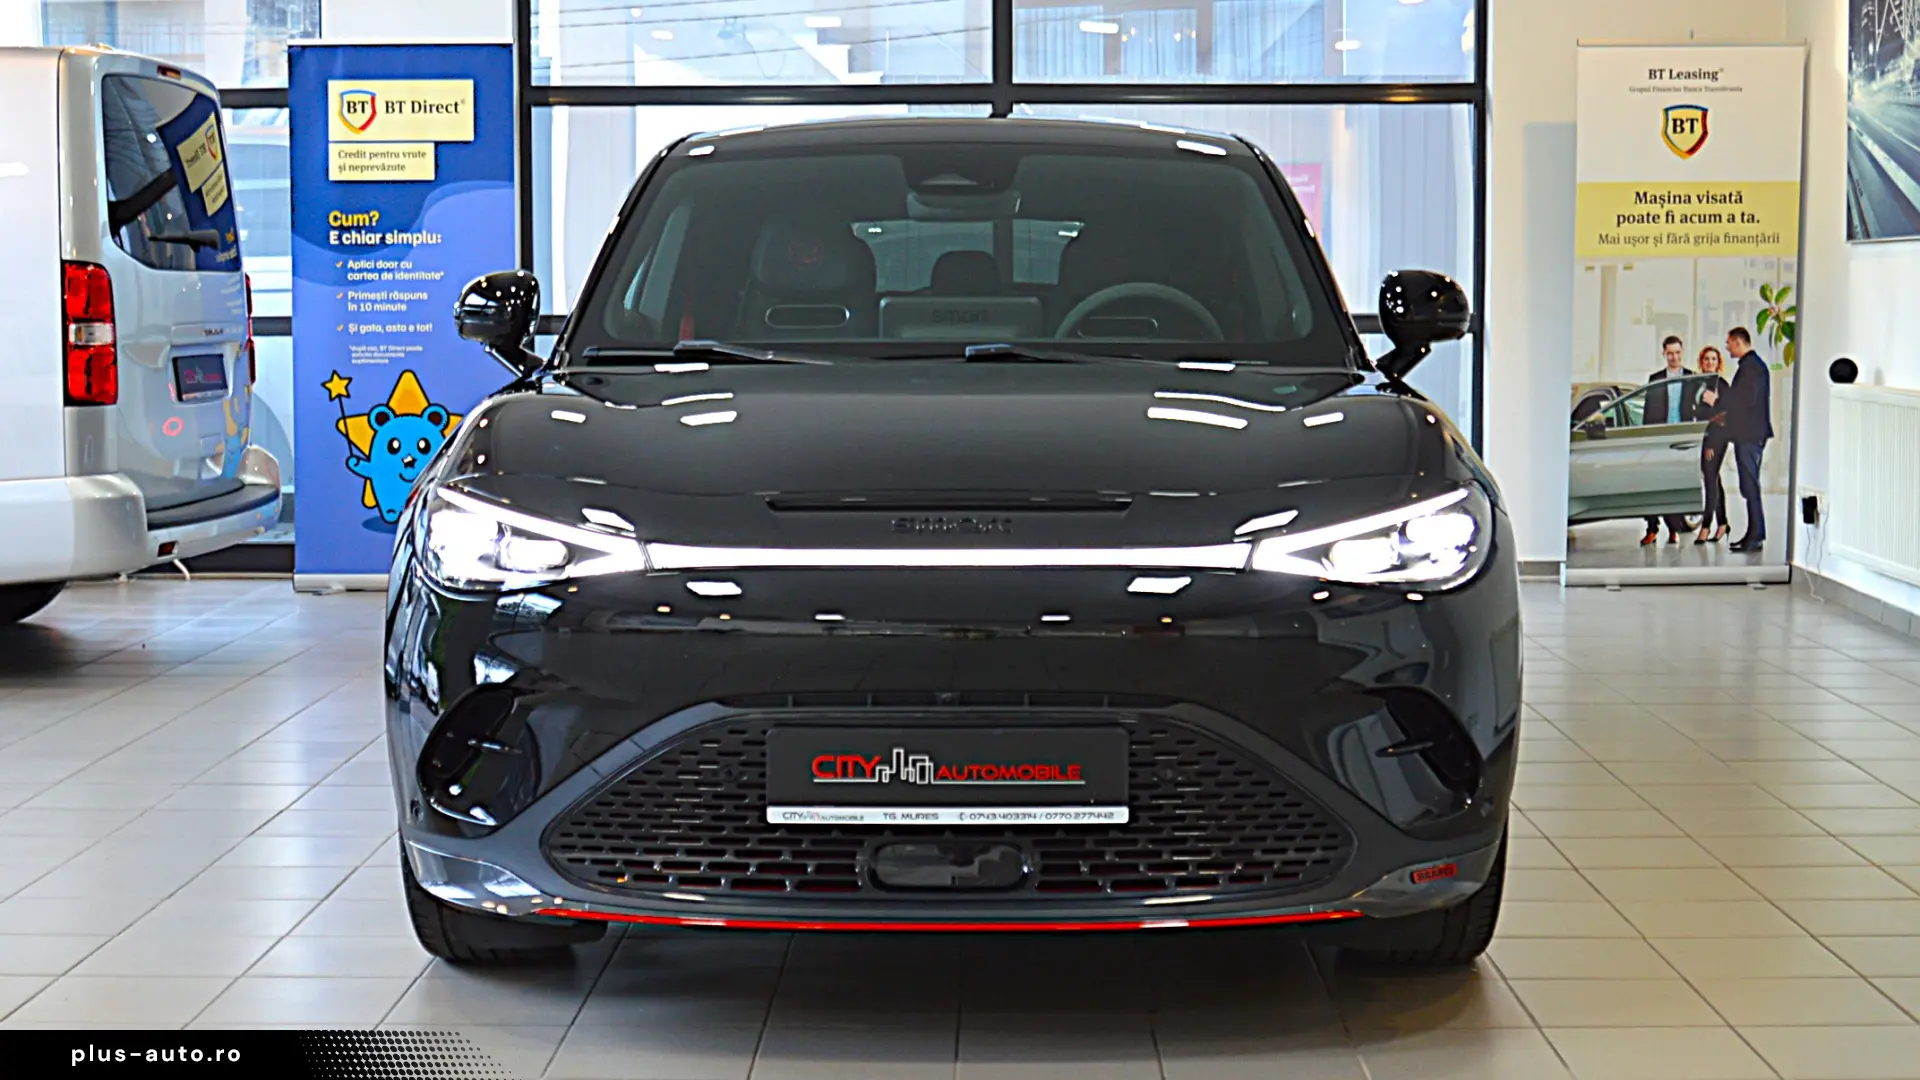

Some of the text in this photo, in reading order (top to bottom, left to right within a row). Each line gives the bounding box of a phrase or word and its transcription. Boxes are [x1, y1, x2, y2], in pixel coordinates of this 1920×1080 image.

[1648, 68, 1719, 82] BT Leasing
[346, 101, 369, 114] BT
[385, 100, 460, 114] BT Direct
[1672, 118, 1699, 134] BT
[338, 150, 427, 161] Credit pentru vrute
[338, 163, 406, 174] și neprevăzute
[1634, 190, 1744, 208] Mașina visată
[328, 210, 380, 227] Cum?
[1616, 210, 1760, 227] poate fi acum a ta.
[330, 230, 442, 247] E chiar simplu:
[1598, 232, 1780, 248] Mai ușor și fără grija finanțării
[348, 260, 412, 270] Aplici doar cu
[348, 272, 379, 280] cartea
[381, 271, 393, 280] de
[389, 290, 428, 302] răspuns
[360, 302, 372, 312] 10
[374, 302, 407, 312] minute
[360, 324, 384, 334] gata,
[386, 324, 407, 332] asta
[408, 324, 415, 332] e
[416, 323, 432, 332] tot!
[812, 755, 1082, 780] CITY AUTOMOBILE
[782, 812, 804, 820] CITY
